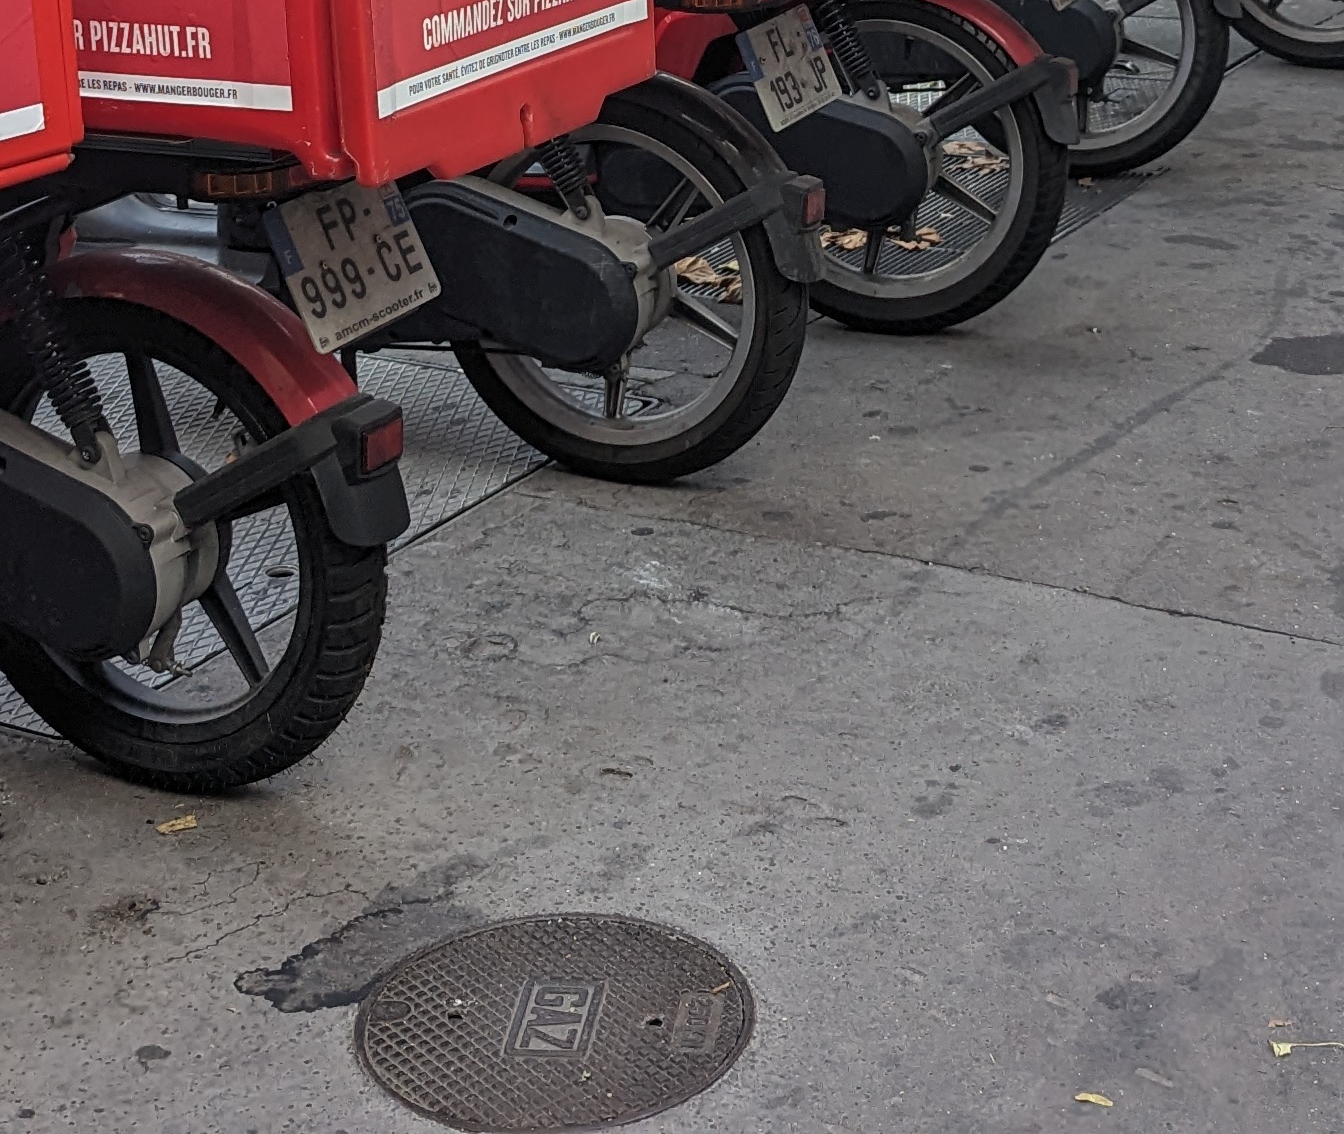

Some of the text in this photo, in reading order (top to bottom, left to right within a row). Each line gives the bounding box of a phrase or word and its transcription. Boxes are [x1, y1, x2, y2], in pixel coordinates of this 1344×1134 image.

[90, 21, 212, 59] PIZZAHUT.FR
[87, 78, 102, 91] LES
[334, 288, 424, 341] amcm-scooter.fr
[519, 986, 588, 1049] GAZ
